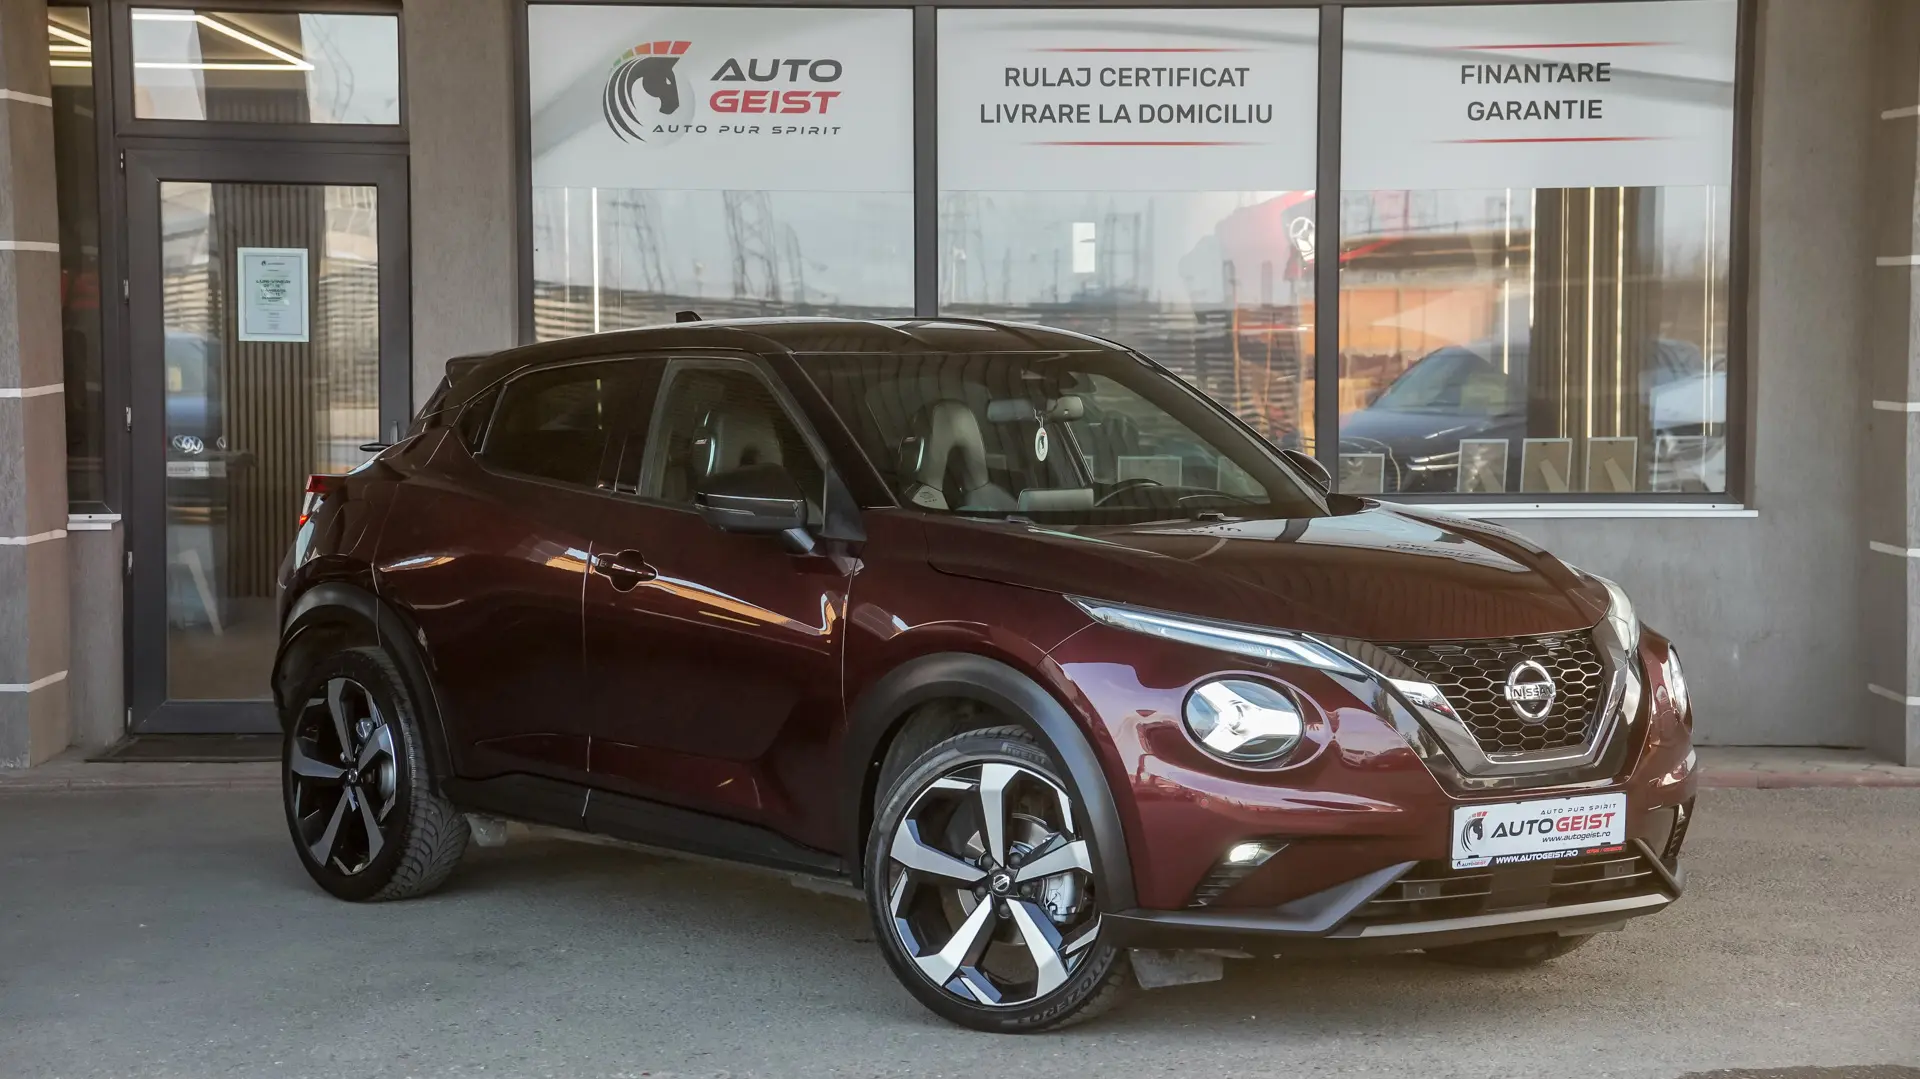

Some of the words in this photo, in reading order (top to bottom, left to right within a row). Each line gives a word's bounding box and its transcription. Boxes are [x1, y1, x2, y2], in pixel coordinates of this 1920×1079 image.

[709, 57, 843, 83] AUTO
[1004, 66, 1092, 88] RULAJ
[1099, 66, 1250, 88] CERTIFICAT
[1461, 62, 1611, 85] FINANTARE
[709, 89, 842, 115] GEIST
[1467, 99, 1603, 121] GARANTIE
[980, 103, 1091, 124] LIVRARE
[1098, 103, 1132, 124] LA
[1138, 103, 1273, 124] DOMICILIU
[652, 124, 708, 134] AUTO
[718, 124, 761, 135] PUR
[771, 125, 842, 136] SPIRIT
[1513, 684, 1553, 698] NISSAN
[1540, 807, 1564, 816] AUTO
[1588, 803, 1617, 811] SPIRIT
[1541, 831, 1611, 843] www.autogeist.ro
[1495, 849, 1579, 865] WWW.AUTOGEIST.RO
